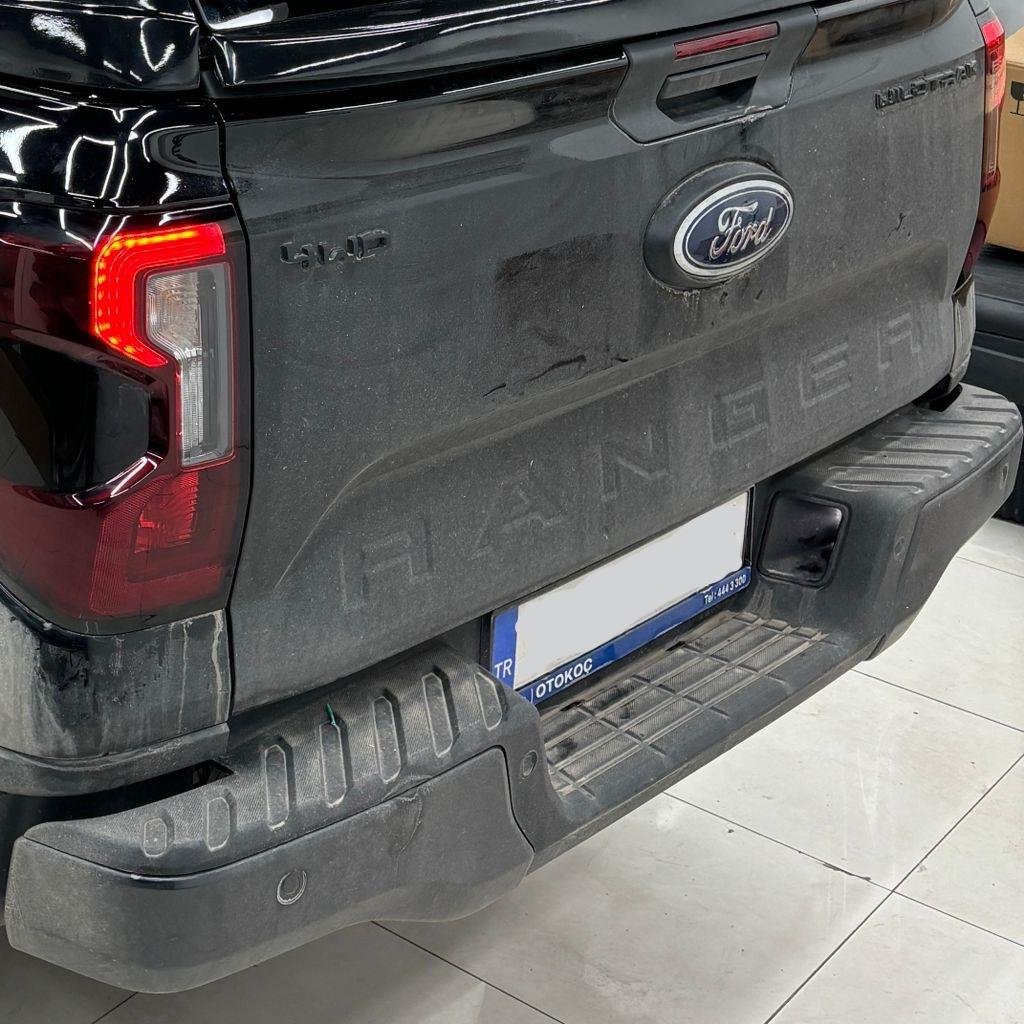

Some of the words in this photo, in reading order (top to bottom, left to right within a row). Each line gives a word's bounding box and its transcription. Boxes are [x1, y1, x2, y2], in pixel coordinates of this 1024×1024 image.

[709, 201, 774, 260] Ford
[339, 311, 921, 613] RANGER
[494, 658, 513, 679] TR
[536, 657, 593, 698] OTOKOÇ
